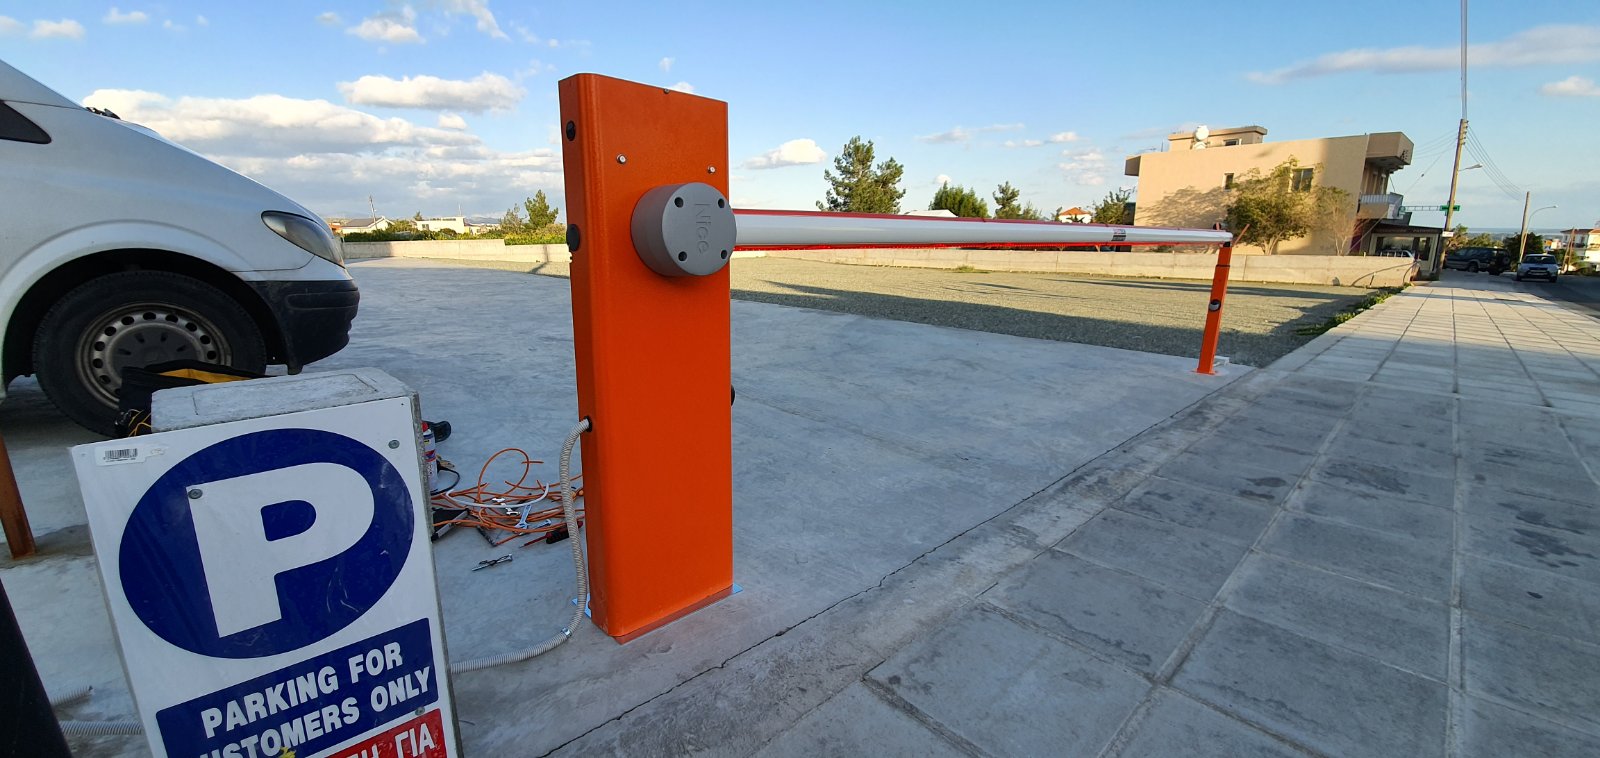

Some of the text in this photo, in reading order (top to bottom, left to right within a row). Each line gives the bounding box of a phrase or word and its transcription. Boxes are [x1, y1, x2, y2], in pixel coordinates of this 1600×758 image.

[186, 462, 375, 638] P
[201, 641, 402, 739] PARKING FOR
[370, 666, 431, 712] ONLY
